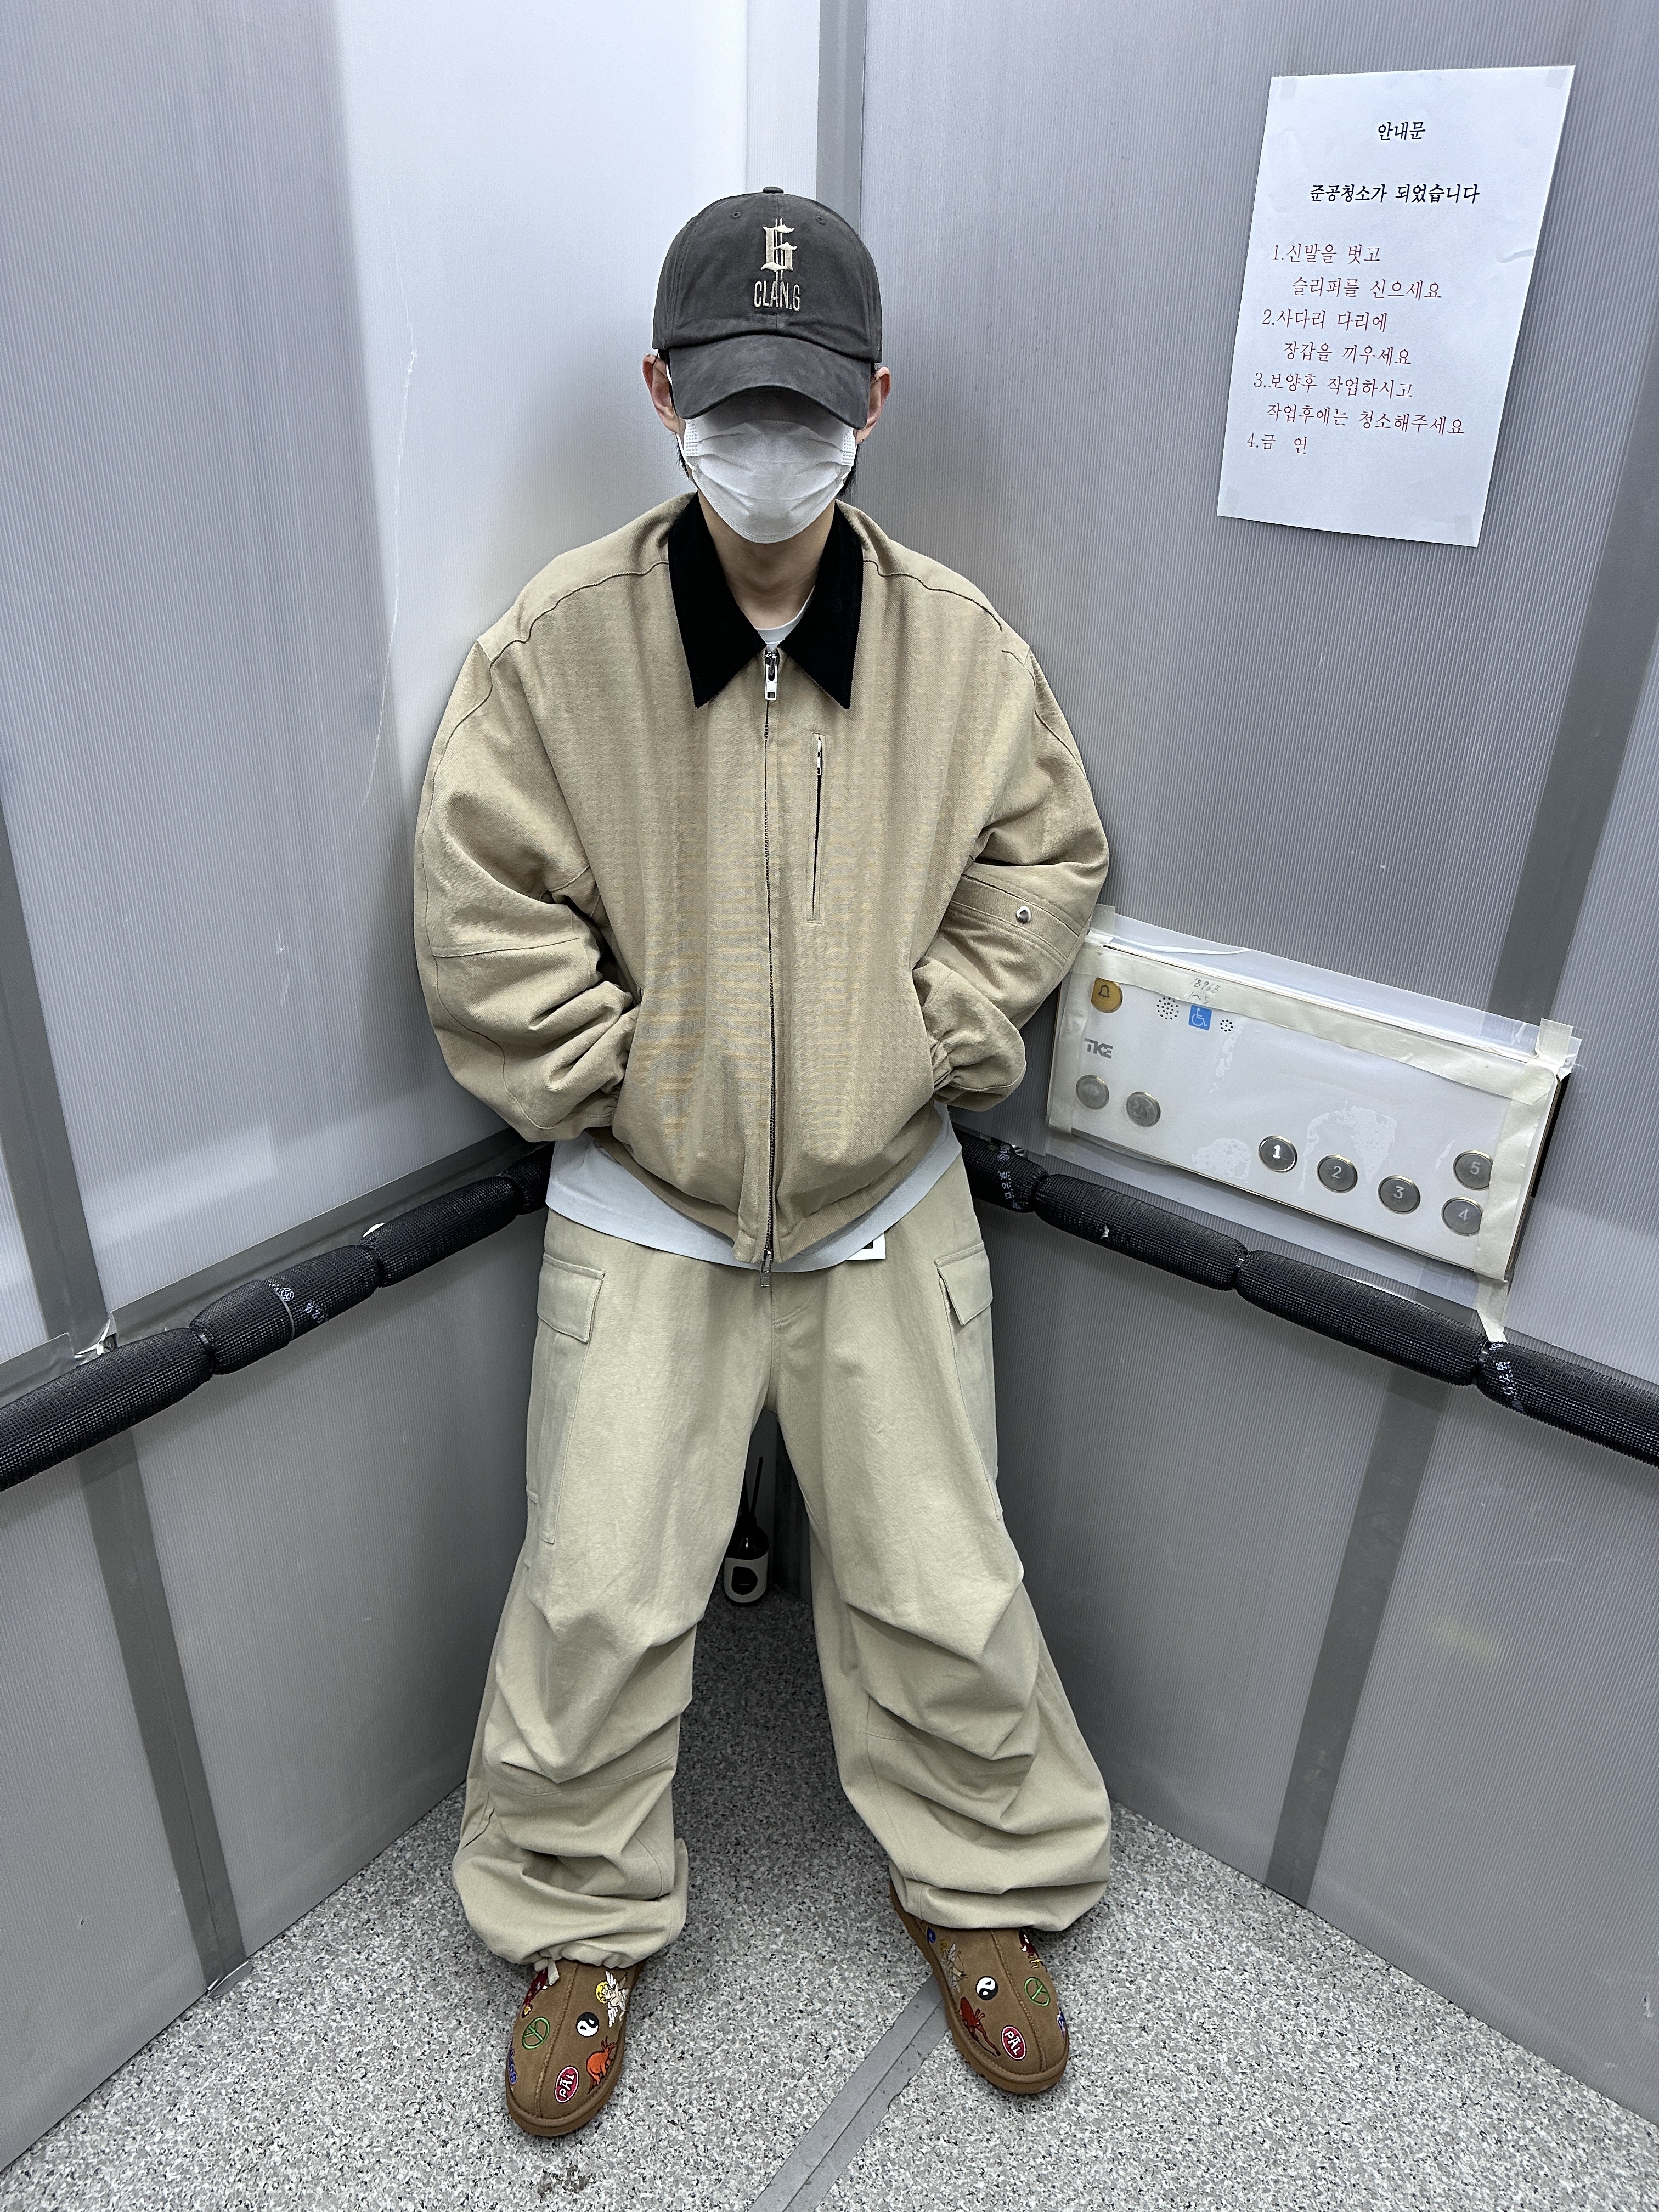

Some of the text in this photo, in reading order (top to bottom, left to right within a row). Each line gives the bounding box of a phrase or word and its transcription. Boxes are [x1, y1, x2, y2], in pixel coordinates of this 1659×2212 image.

[1378, 121, 1426, 141] 안내문
[1310, 183, 1481, 204] 준공청소가 되었습니다
[1272, 243, 1380, 264] 1.신발을 벗고
[754, 280, 800, 312] CLAN.G
[1292, 276, 1442, 301] 슬리퍼를 신으세요
[1262, 308, 1387, 333] 2.사다리 다리에
[1283, 341, 1412, 366] 장갑을 끼우세요
[1254, 373, 1413, 400] 3.보양후 작업하시고
[1267, 403, 1465, 436] 작업후에는 청소해주세요
[1246, 433, 1307, 454] 4.금 연
[1084, 1037, 1113, 1059] TKE
[1273, 1146, 1282, 1159] 1
[1331, 1166, 1342, 1179] 2
[1470, 1162, 1481, 1175] 5
[1393, 1186, 1403, 1199] 3
[1458, 1209, 1469, 1222] 4
